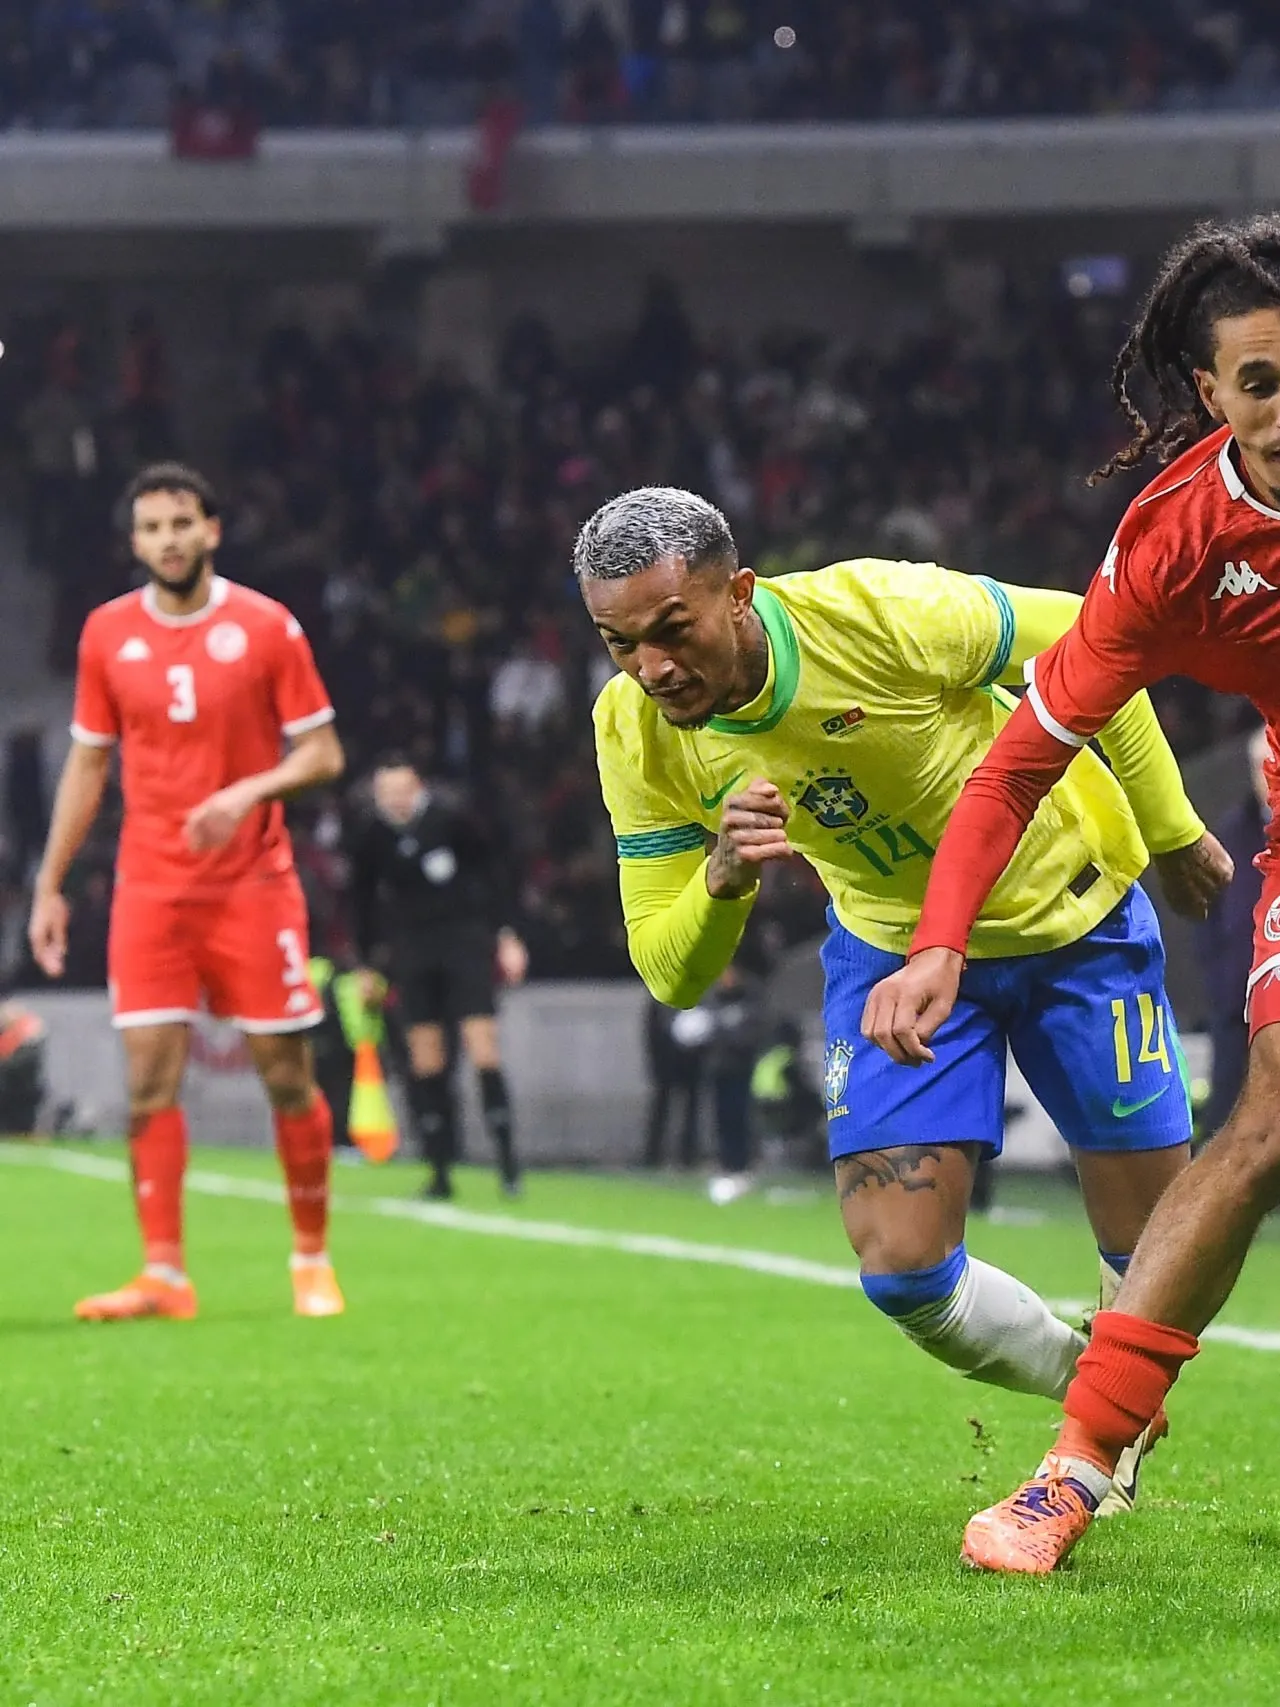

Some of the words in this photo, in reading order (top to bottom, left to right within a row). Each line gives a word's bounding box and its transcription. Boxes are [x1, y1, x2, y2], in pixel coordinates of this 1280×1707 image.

[166, 664, 197, 723] 3
[823, 794, 843, 807] CBF
[855, 822, 935, 877] 14
[276, 929, 304, 988] 3
[1111, 993, 1172, 1083] 14
